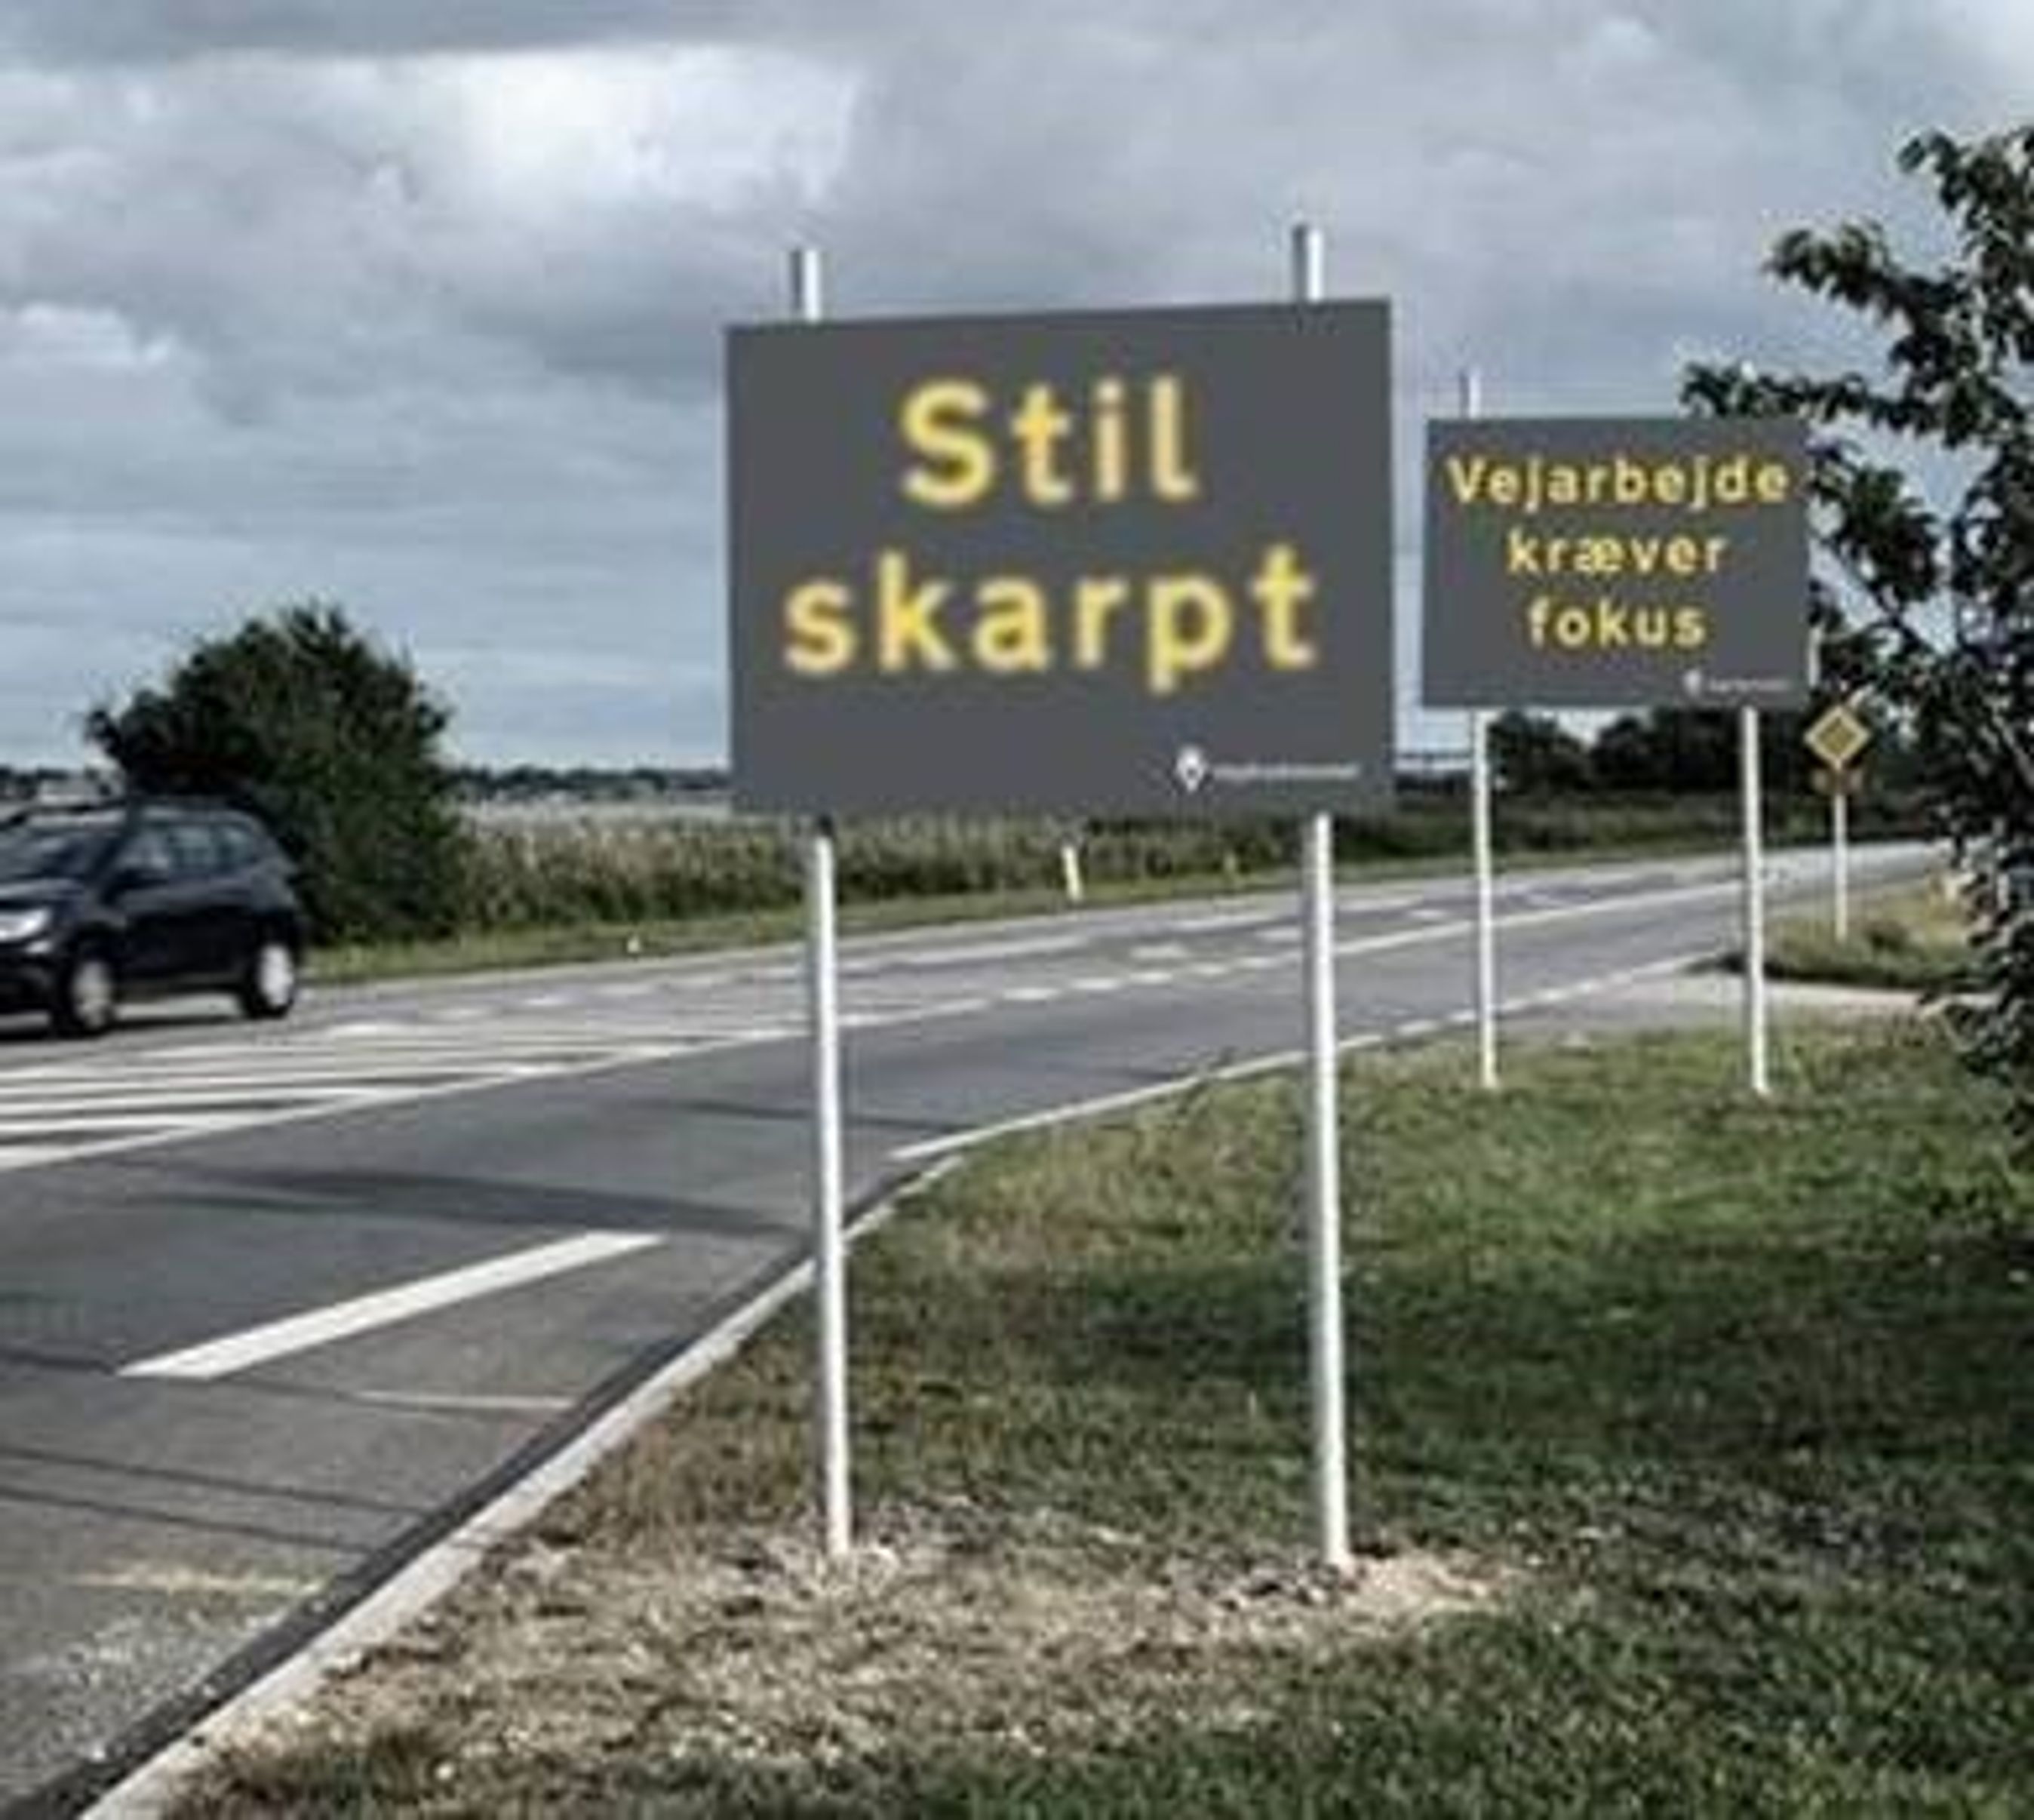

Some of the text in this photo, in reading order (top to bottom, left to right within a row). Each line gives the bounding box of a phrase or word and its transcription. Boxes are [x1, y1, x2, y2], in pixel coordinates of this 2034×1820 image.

[899, 373, 1200, 509] Stil
[1446, 453, 1791, 512] Vejarbejde
[1506, 527, 1727, 574] kræver
[783, 544, 1317, 695] skarpt
[1527, 597, 1708, 648] fokus
